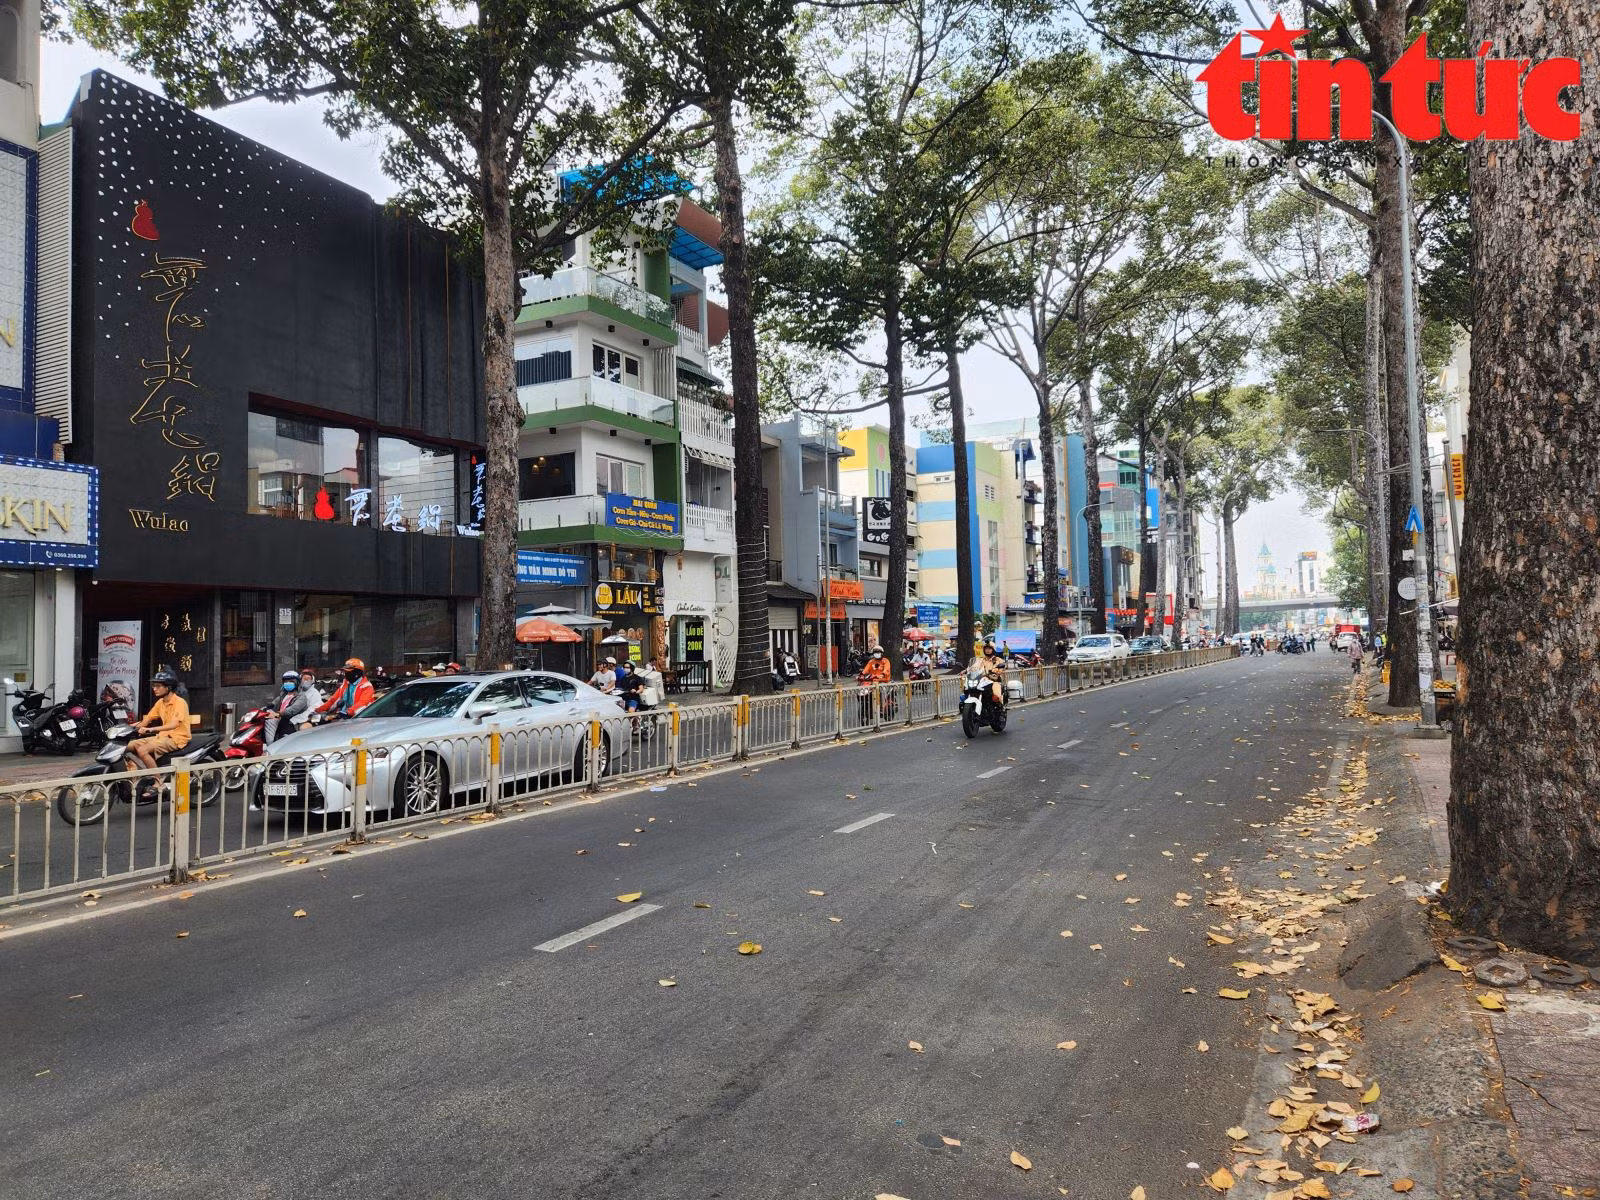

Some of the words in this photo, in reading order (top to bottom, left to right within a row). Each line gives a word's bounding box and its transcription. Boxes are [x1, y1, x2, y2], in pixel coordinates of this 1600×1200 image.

[0, 495, 71, 536] KIN
[129, 508, 190, 532] Wulao
[687, 641, 703, 650] 200K
